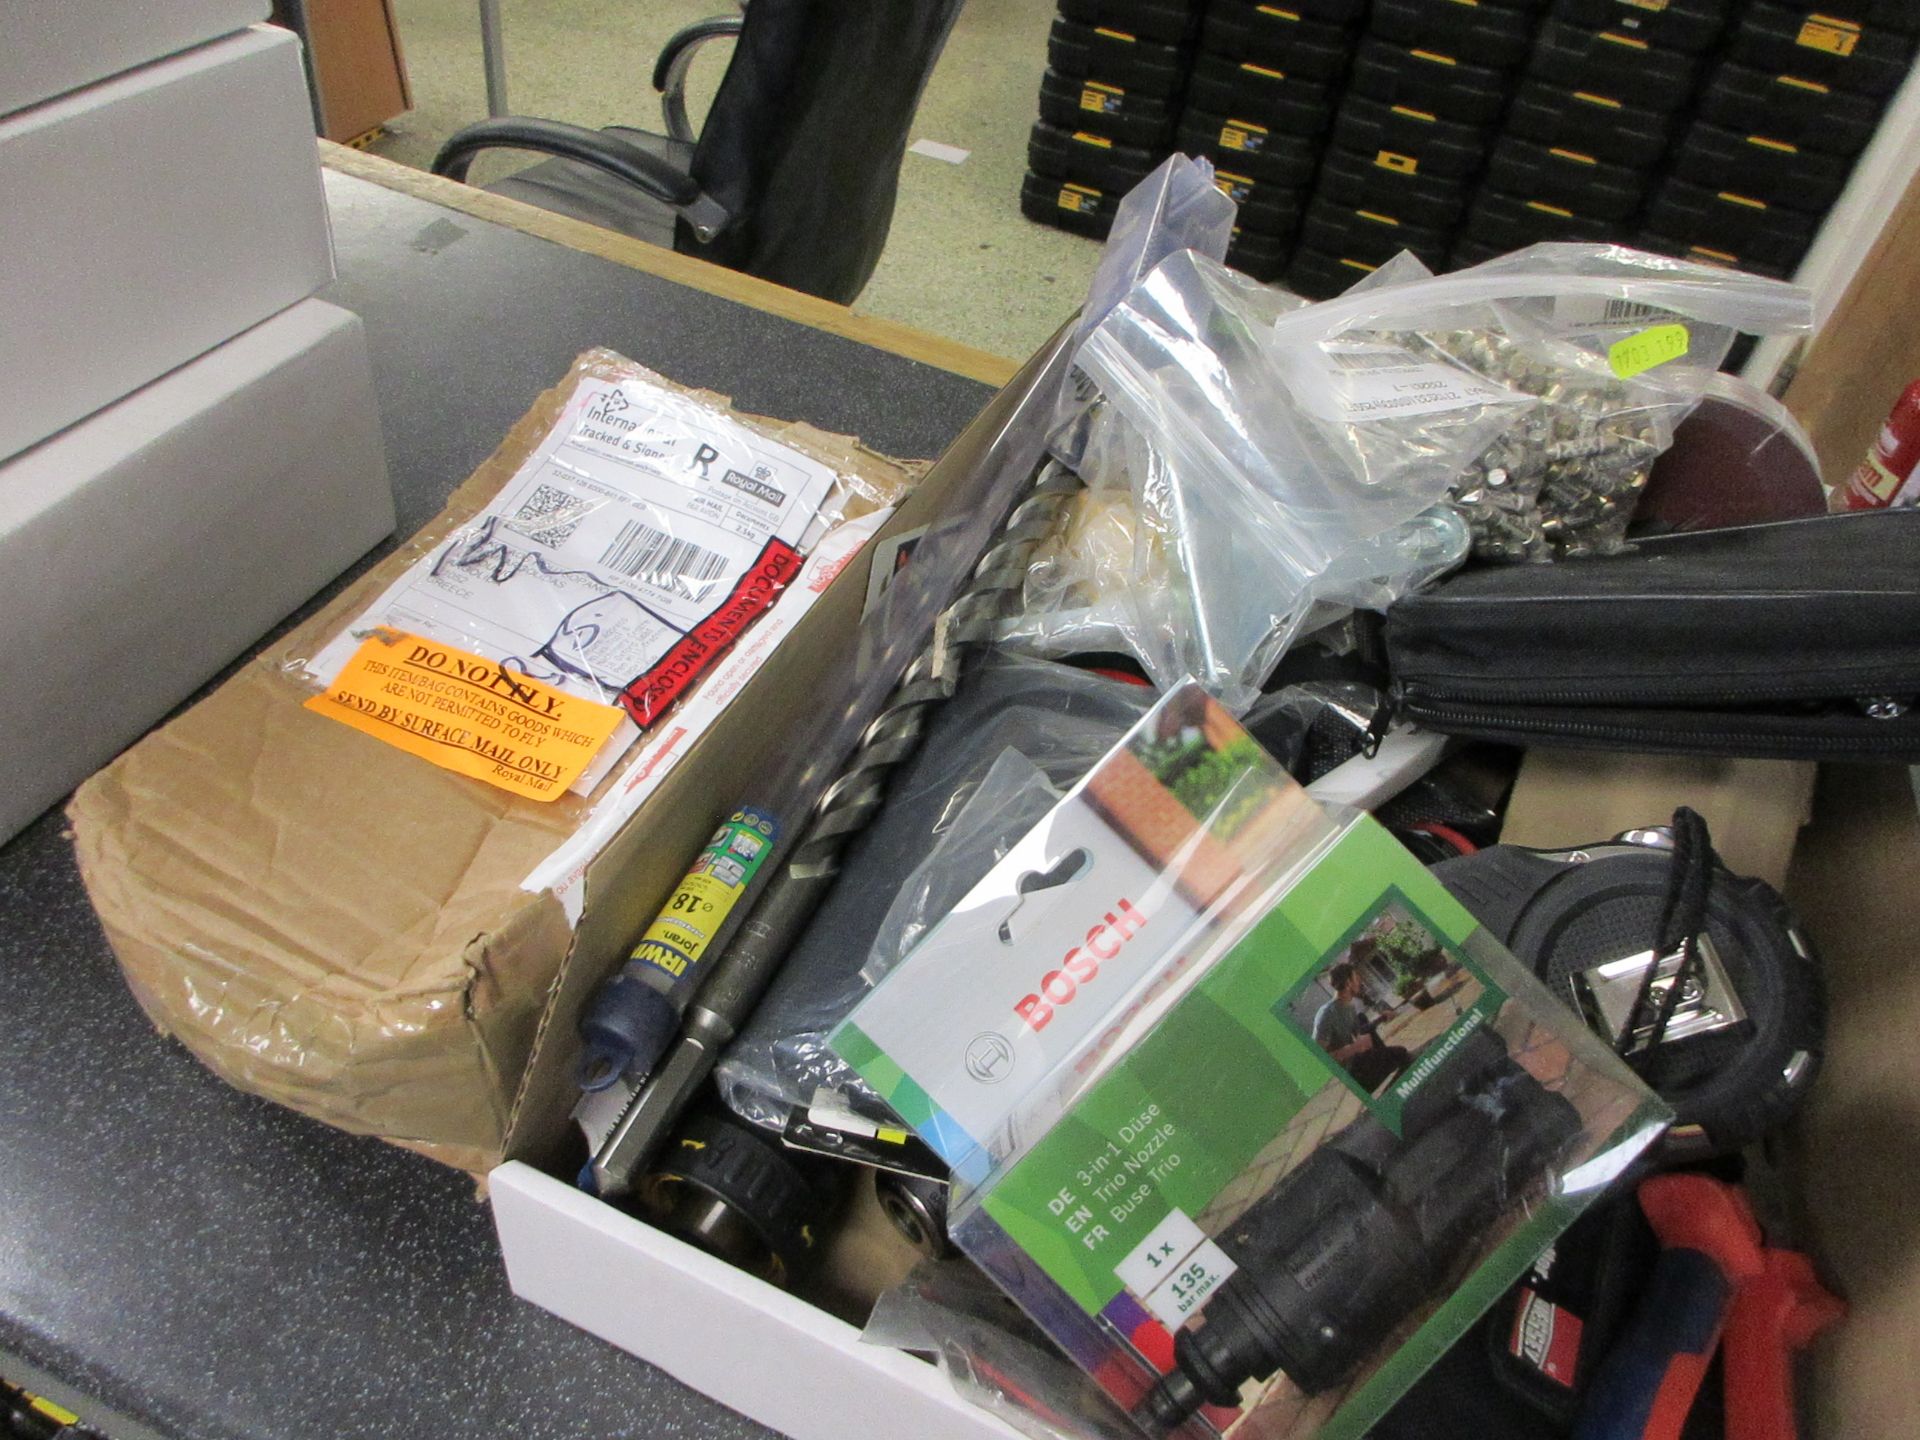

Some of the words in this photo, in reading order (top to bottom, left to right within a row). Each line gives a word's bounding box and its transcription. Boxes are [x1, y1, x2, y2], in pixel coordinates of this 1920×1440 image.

[577, 424, 620, 446] Tracked
[622, 439, 631, 450] &
[635, 443, 675, 463] Signe
[705, 499, 724, 512] MAIL
[726, 472, 757, 497] Royal
[757, 483, 784, 502] Mail
[735, 510, 770, 530] Documents
[703, 550, 791, 643] DOCUMENTS
[407, 645, 447, 670] DO
[448, 659, 508, 690] NOT
[363, 660, 395, 679] THIS
[443, 682, 508, 716] CONTAINS
[507, 706, 551, 736] GOODS
[551, 720, 594, 748] WHICH
[381, 682, 406, 700] ARE
[408, 687, 434, 709] NOT
[433, 696, 500, 729] PERMITTED
[501, 720, 519, 738] TO
[519, 725, 548, 748] FLY
[336, 691, 377, 715] SEND
[379, 704, 402, 724] BY
[400, 712, 467, 745] SURFACE
[469, 735, 516, 763] MAIL
[519, 753, 568, 780] ONLY
[492, 764, 526, 785] Royal
[525, 774, 552, 792] Mail
[672, 893, 703, 914] 18
[629, 943, 688, 977] IRWI
[1014, 898, 1147, 1032] BOSCH
[1396, 1008, 1484, 1099] Multifunctional
[1048, 1187, 1076, 1216] DE
[1076, 1141, 1122, 1187] 3-in-1
[1118, 1103, 1161, 1144] Düse
[1065, 1205, 1093, 1234] EN
[1092, 1173, 1127, 1204] Trio
[1122, 1121, 1177, 1170] Nozzle
[1082, 1224, 1110, 1250] FR
[1109, 1182, 1151, 1223] Buse
[1146, 1153, 1182, 1183] Trio
[1147, 1250, 1162, 1269] 1
[1159, 1241, 1175, 1257] x
[1171, 1262, 1206, 1301] 135
[1177, 1294, 1196, 1313] bar
[1196, 1273, 1220, 1298] max.
